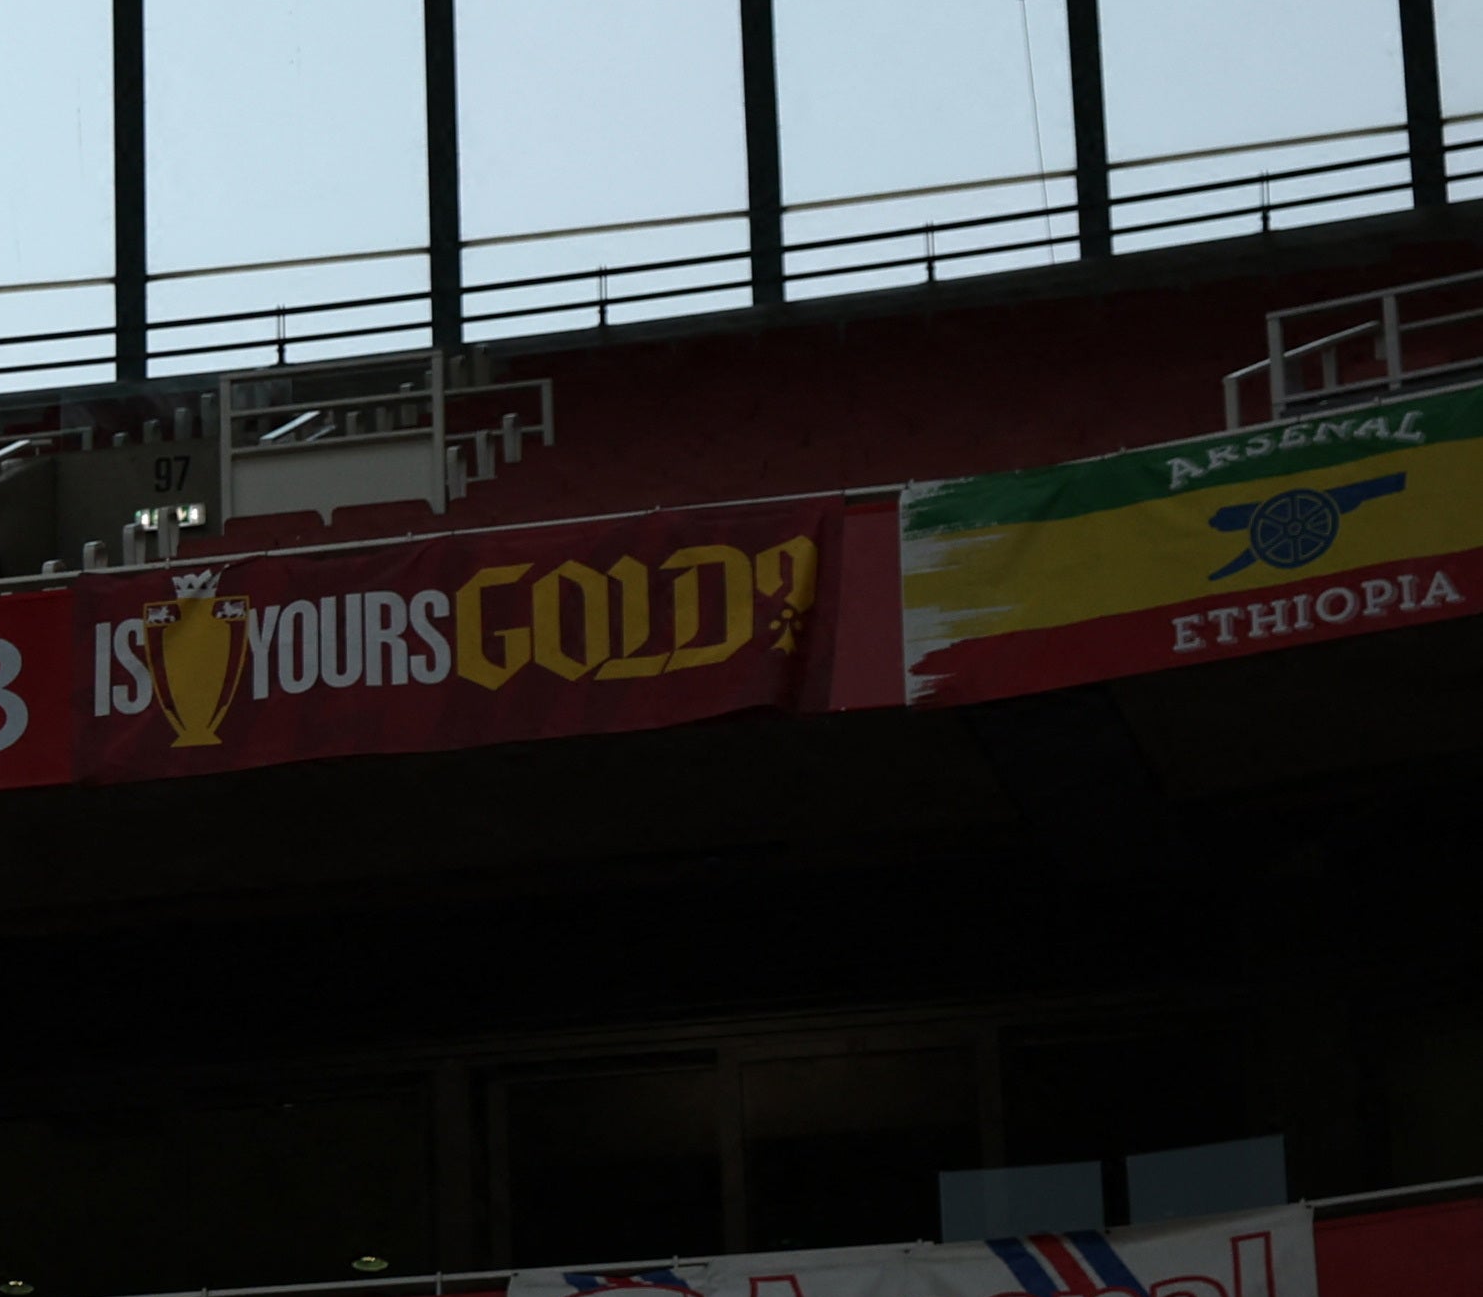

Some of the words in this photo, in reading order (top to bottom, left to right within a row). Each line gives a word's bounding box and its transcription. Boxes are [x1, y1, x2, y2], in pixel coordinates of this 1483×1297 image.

[154, 455, 188, 493] 97
[1166, 410, 1425, 490] ARSENAL
[93, 617, 154, 716] IS
[248, 588, 452, 700] YOURS
[455, 534, 819, 692] GOLD?
[1171, 570, 1465, 653] ETHIOPIA
